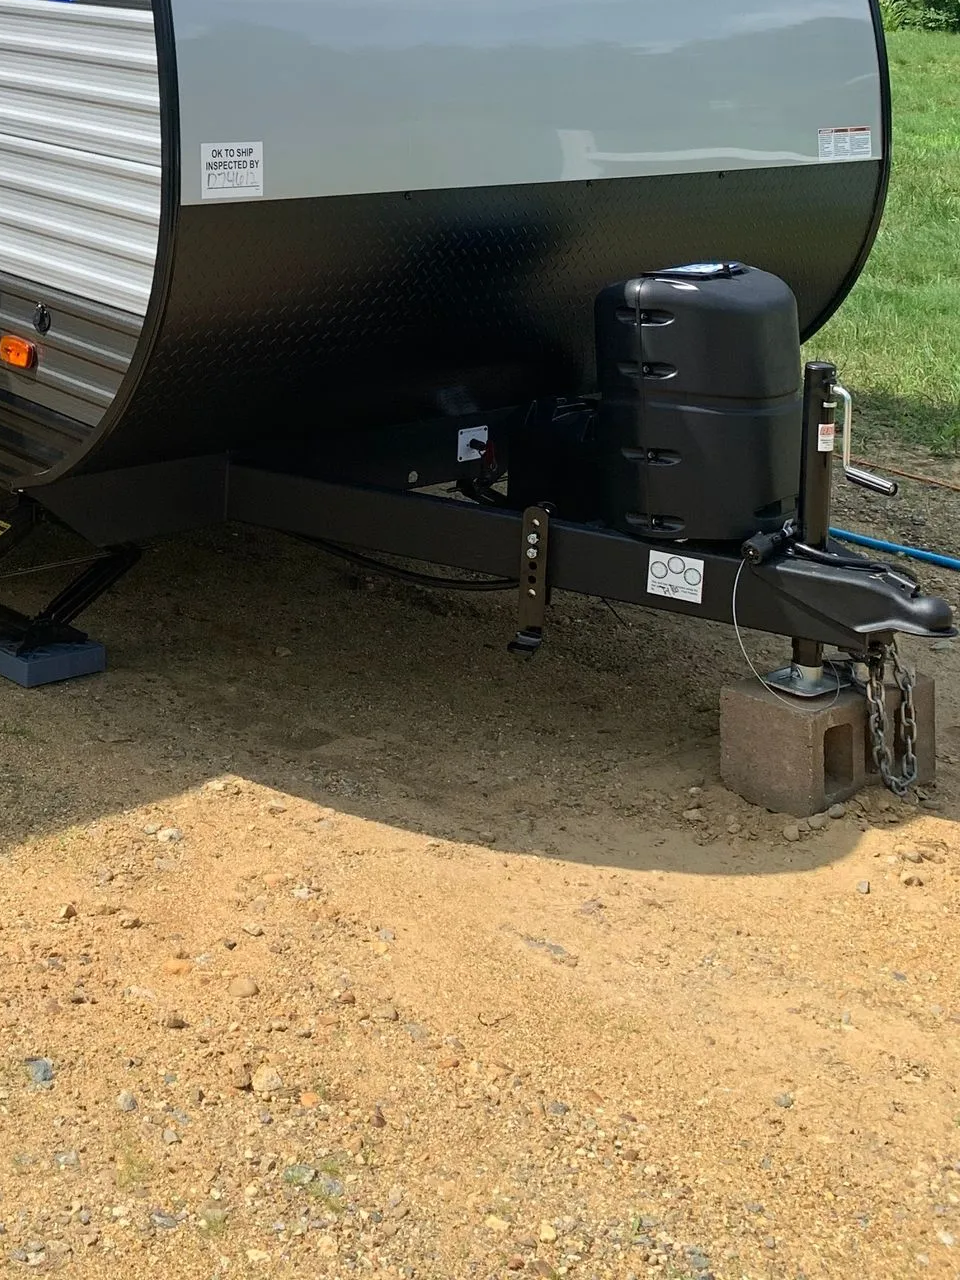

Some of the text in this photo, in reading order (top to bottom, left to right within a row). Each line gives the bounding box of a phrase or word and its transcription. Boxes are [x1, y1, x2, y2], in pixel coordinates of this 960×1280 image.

[211, 147, 254, 158] OK TO SHIP
[205, 159, 260, 171] INSPECTED BY
